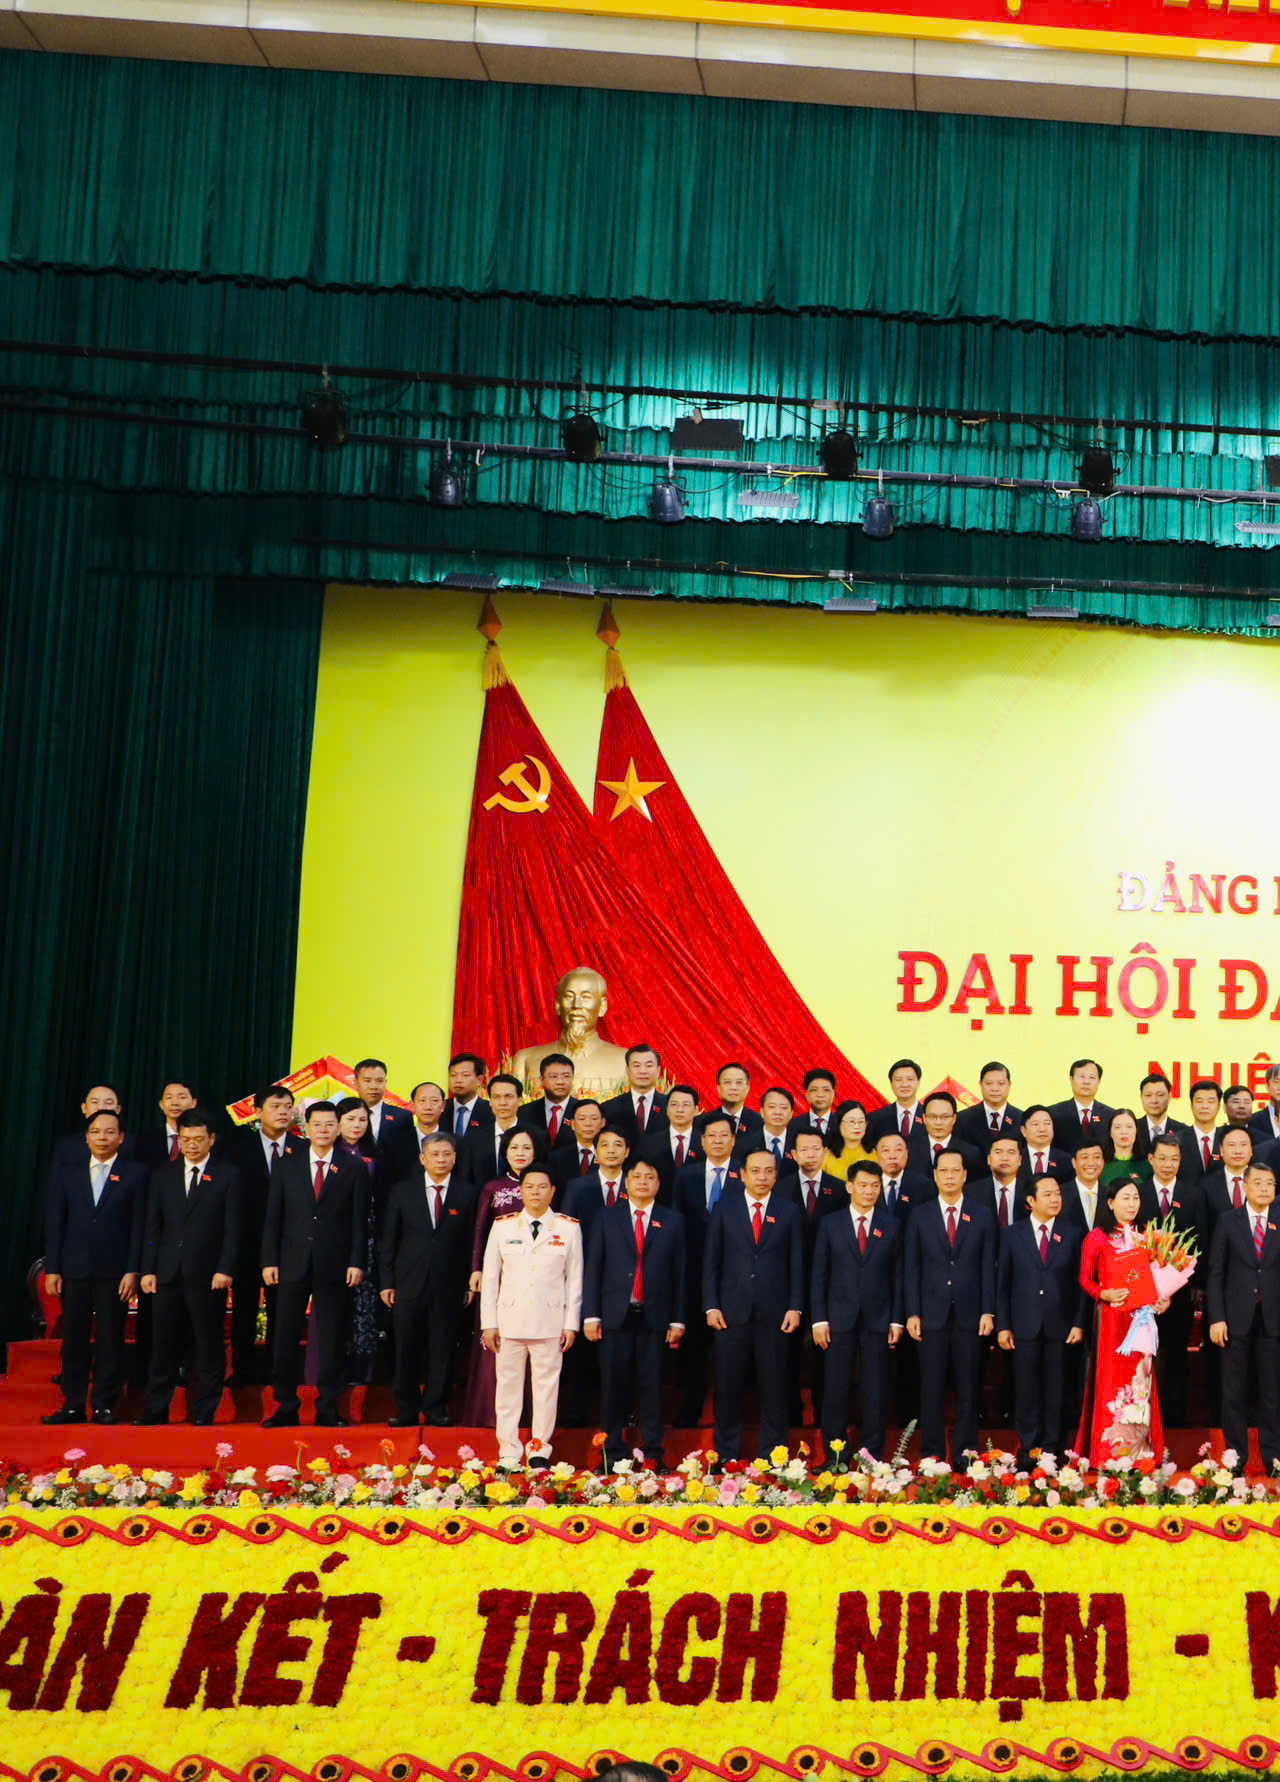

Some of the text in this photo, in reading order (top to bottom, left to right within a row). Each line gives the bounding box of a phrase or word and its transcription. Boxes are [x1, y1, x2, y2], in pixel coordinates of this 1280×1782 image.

[1117, 861, 1259, 915] ĐẢNG
[897, 950, 1034, 1031] ĐẠI
[1055, 942, 1197, 1035] HỘI
[0, 1576, 151, 1712] ÀN
[164, 1551, 383, 1712] KẾT
[470, 1568, 788, 1706] TRÁCH
[832, 1570, 1130, 1722] NHIỆM
